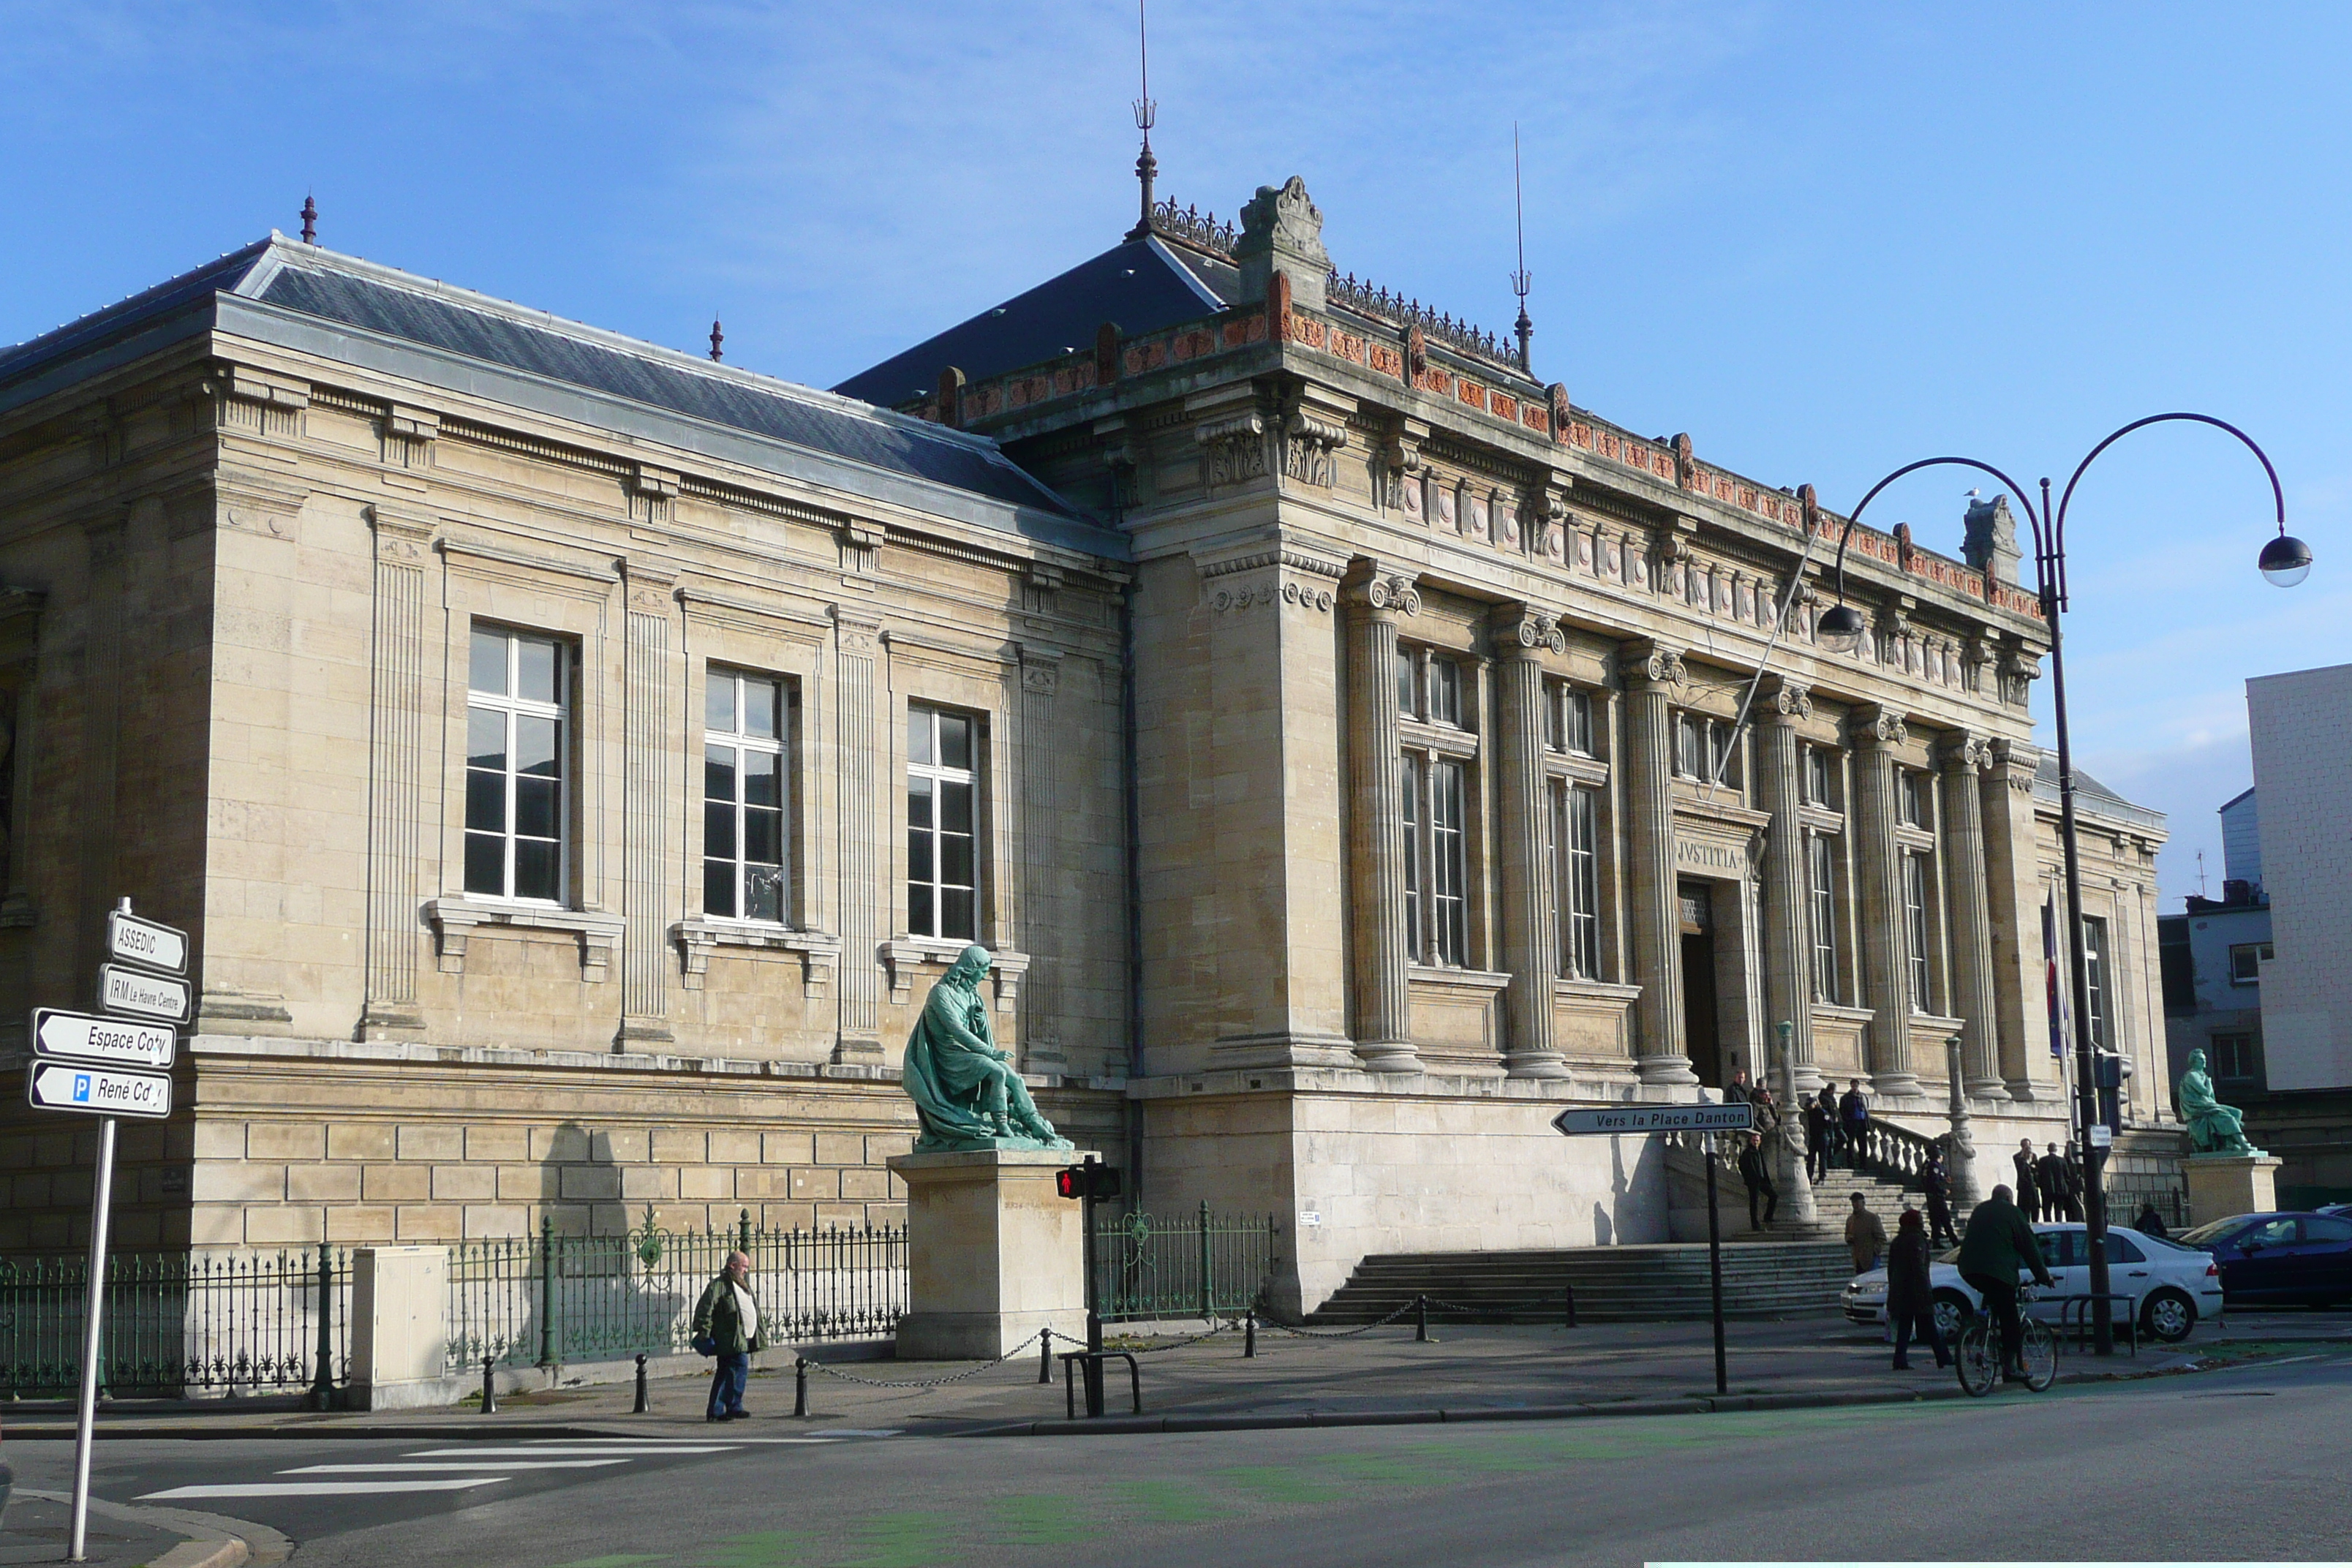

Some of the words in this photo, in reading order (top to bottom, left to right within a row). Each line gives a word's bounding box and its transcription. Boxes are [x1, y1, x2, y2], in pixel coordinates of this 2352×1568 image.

[1678, 840, 1738, 869] JVSTITIA
[118, 927, 156, 954] ASSEDIC
[110, 979, 129, 1000] IRM
[129, 985, 137, 1002] Le
[138, 987, 157, 1006] Havre
[158, 992, 178, 1010] Centre
[88, 1026, 133, 1051] Espace
[77, 1078, 87, 1098] P
[97, 1078, 130, 1099] René
[133, 1082, 162, 1107] Co
[1596, 1114, 1626, 1127] Vers
[1632, 1113, 1645, 1126] la
[1651, 1112, 1689, 1126] Place
[1695, 1111, 1745, 1124] Danton
